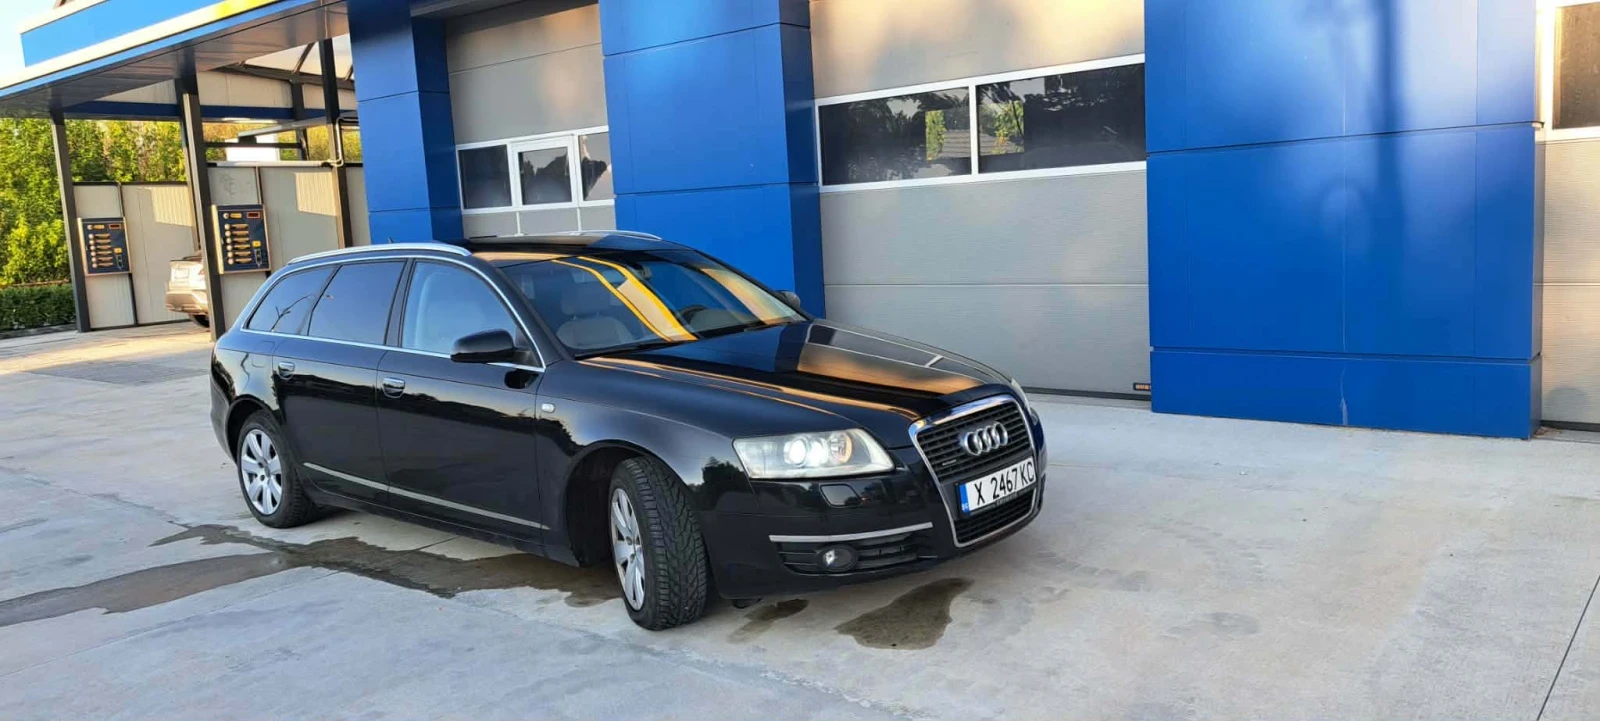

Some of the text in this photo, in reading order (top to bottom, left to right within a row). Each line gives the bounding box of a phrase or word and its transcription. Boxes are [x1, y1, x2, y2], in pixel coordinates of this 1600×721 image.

[974, 481, 985, 506] X
[990, 468, 1018, 500] 2467
[1020, 461, 1035, 487] KC
